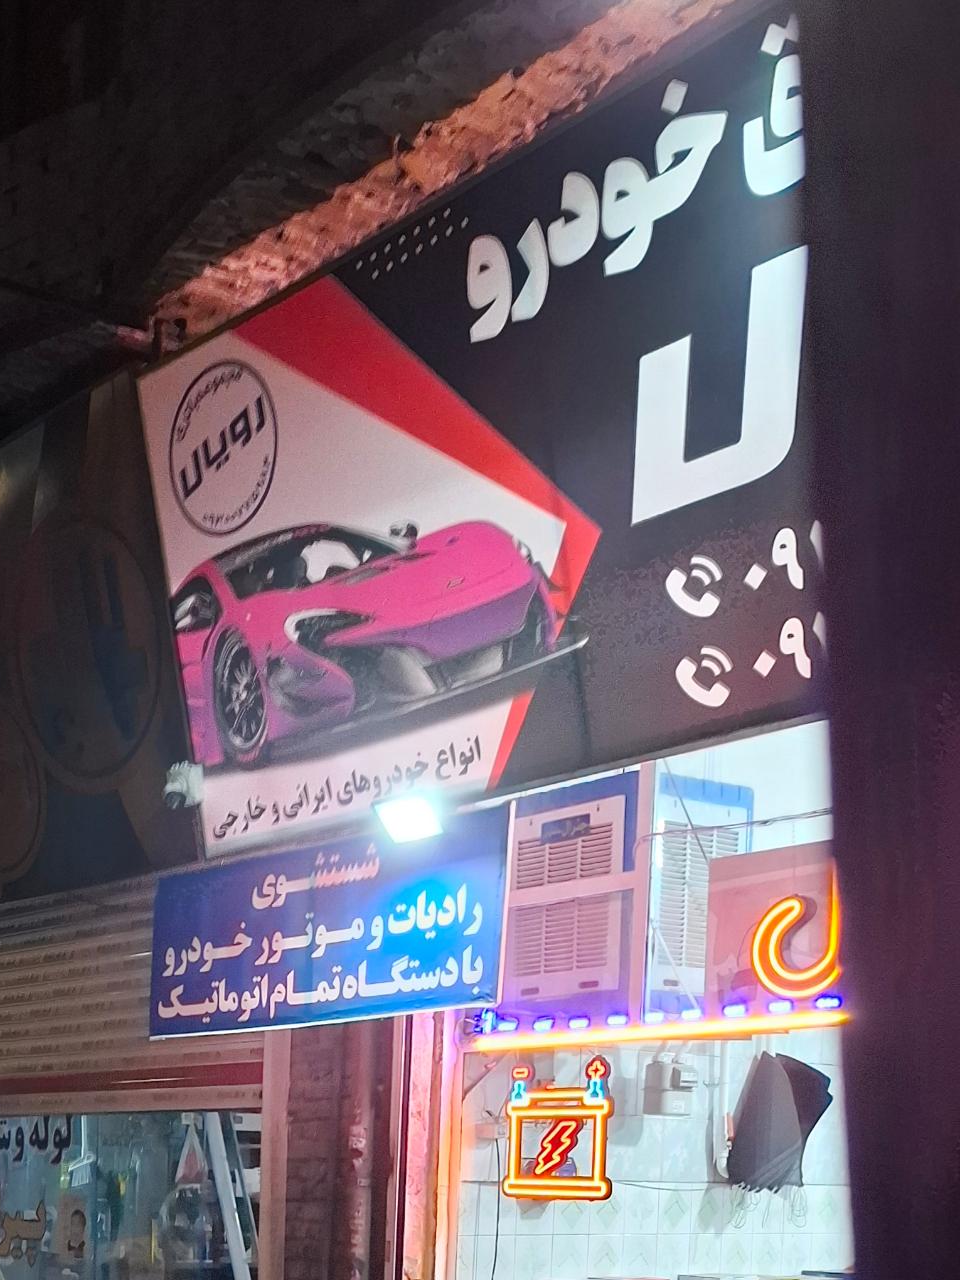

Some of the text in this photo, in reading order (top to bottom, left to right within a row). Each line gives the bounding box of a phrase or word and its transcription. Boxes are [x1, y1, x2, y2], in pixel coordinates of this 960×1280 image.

[466, 78, 728, 343] خودرو
[179, 395, 266, 501] رویال
[435, 735, 482, 780] انواع
[213, 796, 266, 839] خارجی
[283, 777, 332, 819] ایرانی
[162, 883, 483, 977] رادیات و موتور خودرو
[157, 945, 484, 1024] با دستگاه تمام اتوماتیک
[29, 1113, 73, 1165] لوله
